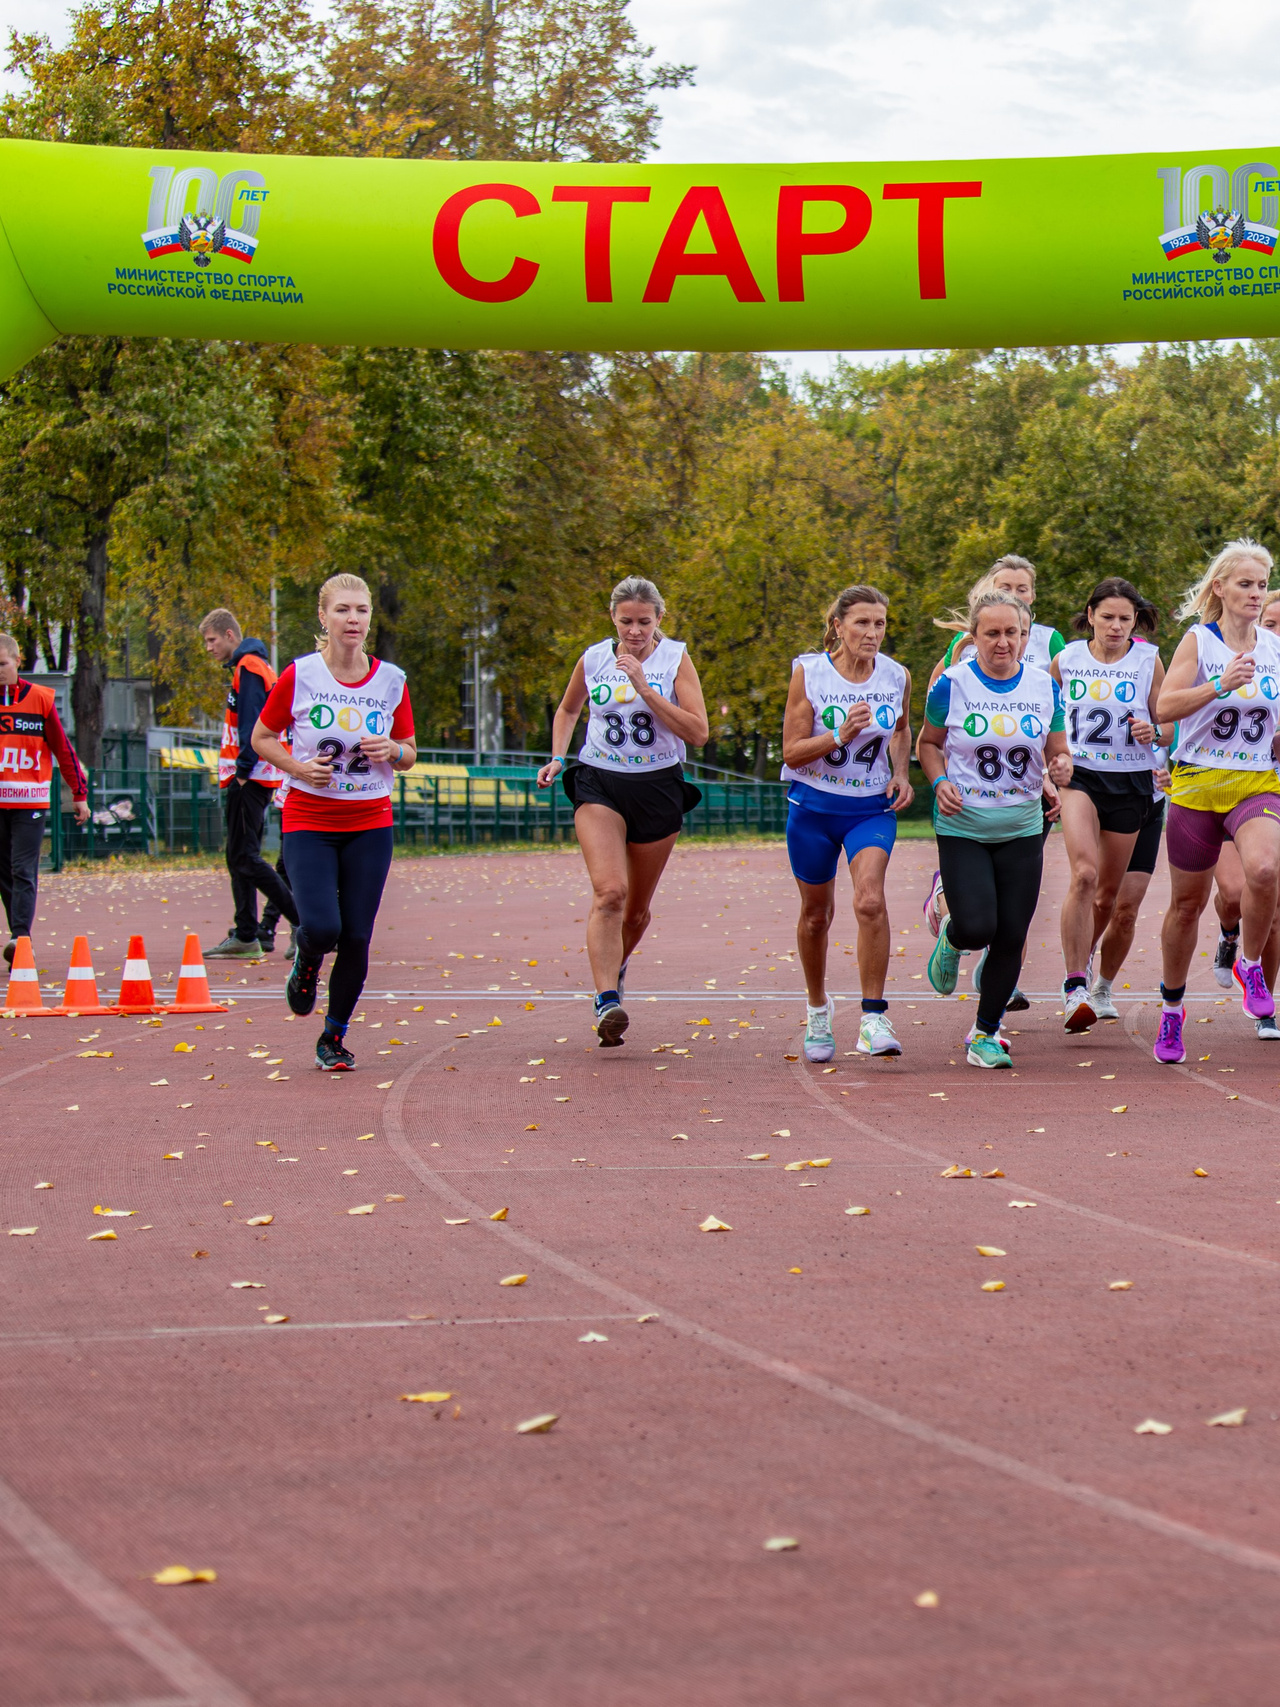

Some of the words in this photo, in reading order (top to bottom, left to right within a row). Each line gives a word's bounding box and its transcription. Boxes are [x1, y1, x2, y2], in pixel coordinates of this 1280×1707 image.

[238, 189, 270, 202] ЛЕТ
[151, 236, 173, 248] 1923
[226, 239, 249, 254] 2023
[432, 181, 983, 303] СТАРТ
[1169, 236, 1191, 249] 1923
[1246, 232, 1271, 245] 2023
[115, 267, 233, 285] МИНИСТЕРСТВО
[238, 274, 296, 288] СПОРТА
[1132, 267, 1254, 285] МИНИСТЕРСТВО
[107, 282, 206, 299] РОССИЙСКОЙ
[210, 289, 304, 305] ФЕДЕРАЦИИ
[1123, 282, 1224, 301] РОССИЙСКОЙ
[1067, 669, 1139, 680] VMARAFONE
[1206, 663, 1277, 674] VMONE
[310, 693, 388, 710] VMARAFONE
[820, 693, 895, 704] VMARAFONE
[964, 701, 1041, 713] VMARAFONE
[15, 718, 44, 731] Sport
[602, 711, 657, 748] 88
[1069, 707, 1135, 747] 121
[1211, 706, 1270, 745] 93
[316, 737, 371, 776] 22
[974, 744, 1032, 783] 89
